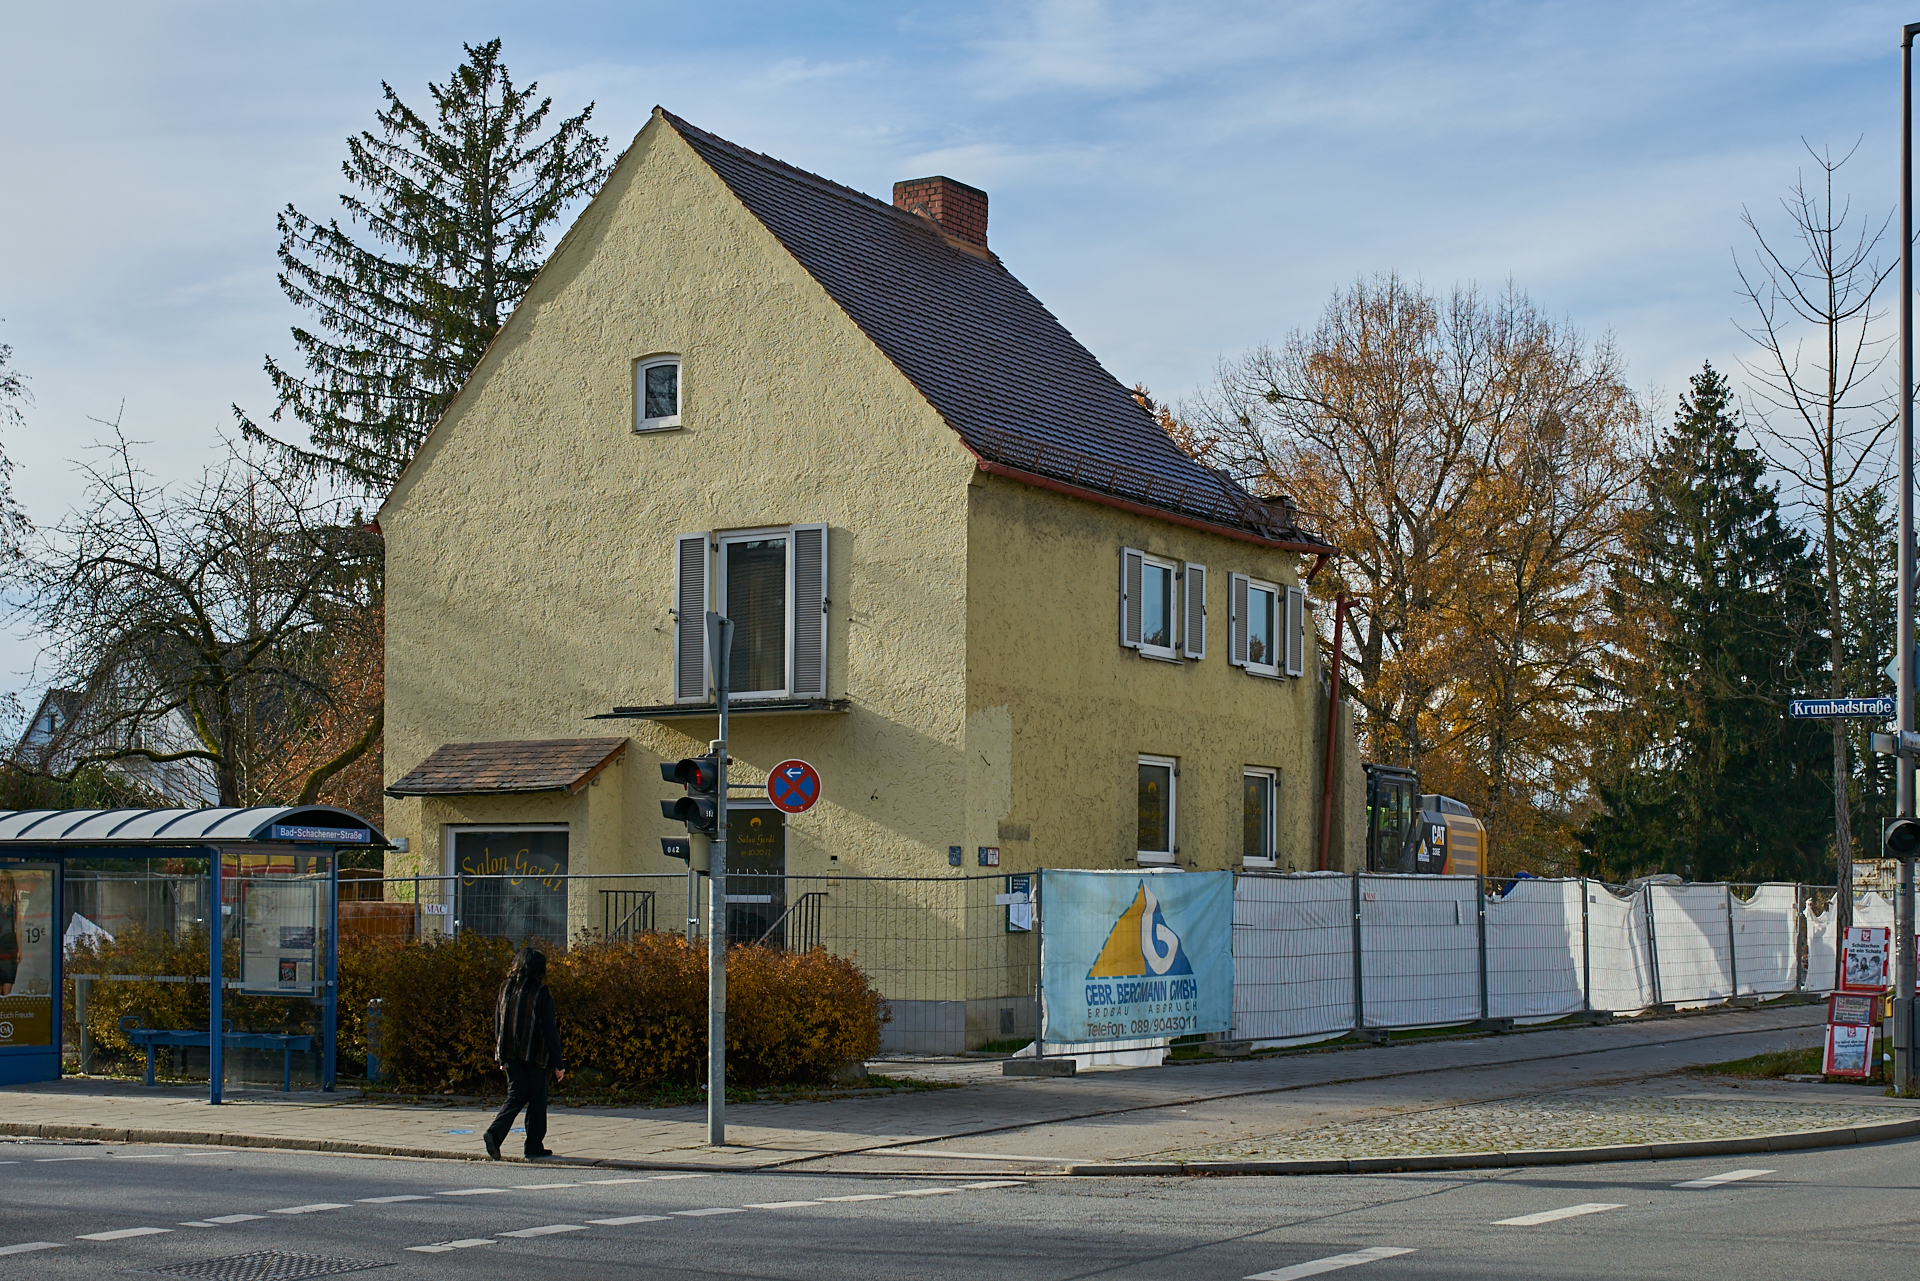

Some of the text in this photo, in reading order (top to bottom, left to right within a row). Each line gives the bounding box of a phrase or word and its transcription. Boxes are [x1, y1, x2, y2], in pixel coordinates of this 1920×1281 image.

[1794, 700, 1892, 715] Krumbadstraße
[280, 827, 363, 840] Bad-Schachener-Straße
[1432, 825, 1445, 845] CAT
[462, 847, 563, 892] Salon Gerdi
[426, 904, 447, 914] MAC
[1085, 978, 1197, 1006] GEBR. BERGMANN GMBH
[14, 1010, 35, 1019] Freude
[1087, 1001, 1198, 1018] ERDBAU ABBRUCH
[1087, 1015, 1197, 1037] Telefon: 089/9043011
